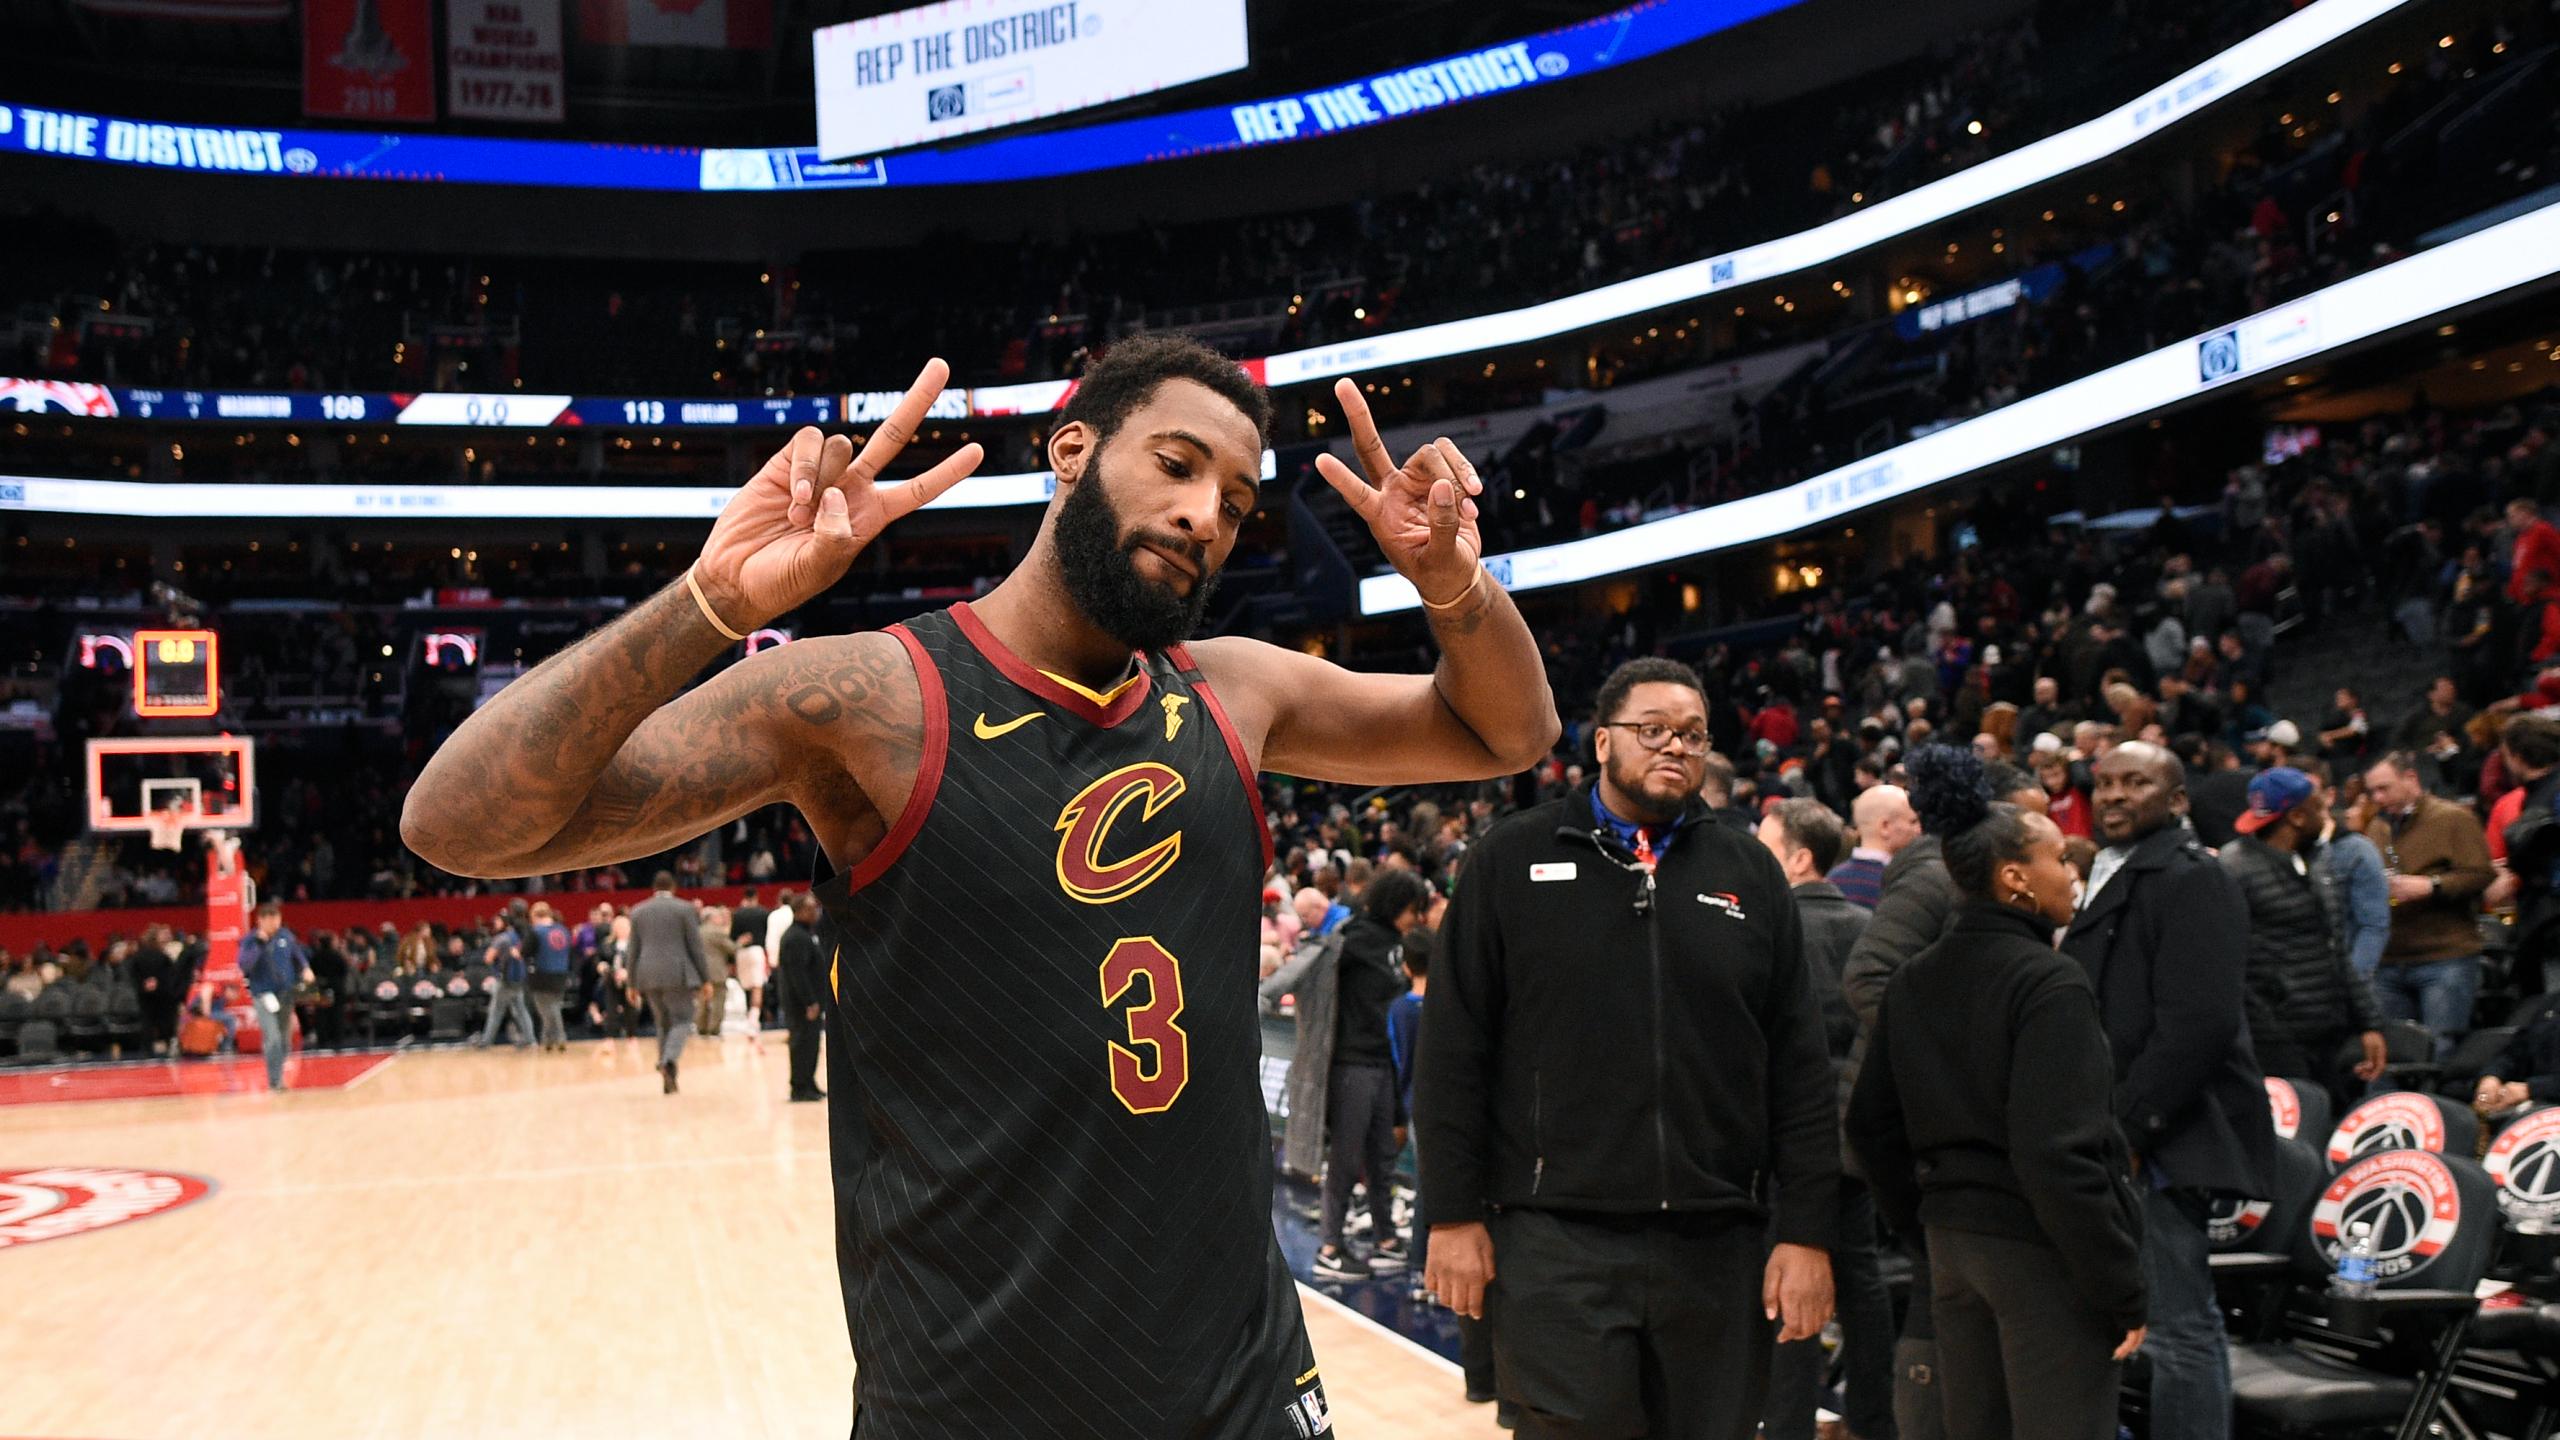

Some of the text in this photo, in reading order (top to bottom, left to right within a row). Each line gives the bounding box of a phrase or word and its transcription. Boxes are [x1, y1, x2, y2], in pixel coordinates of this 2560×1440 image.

[856, 2, 1078, 87] REP THE DISTRICT
[1231, 41, 1539, 144] REP THE DISTRICT
[20, 108, 99, 157] THE
[104, 120, 285, 172] DISTRICT
[321, 394, 365, 420] 108
[467, 396, 508, 425] 0.0
[623, 400, 665, 425] 113
[1054, 762, 1186, 904] C
[1099, 935, 1189, 1114] 3
